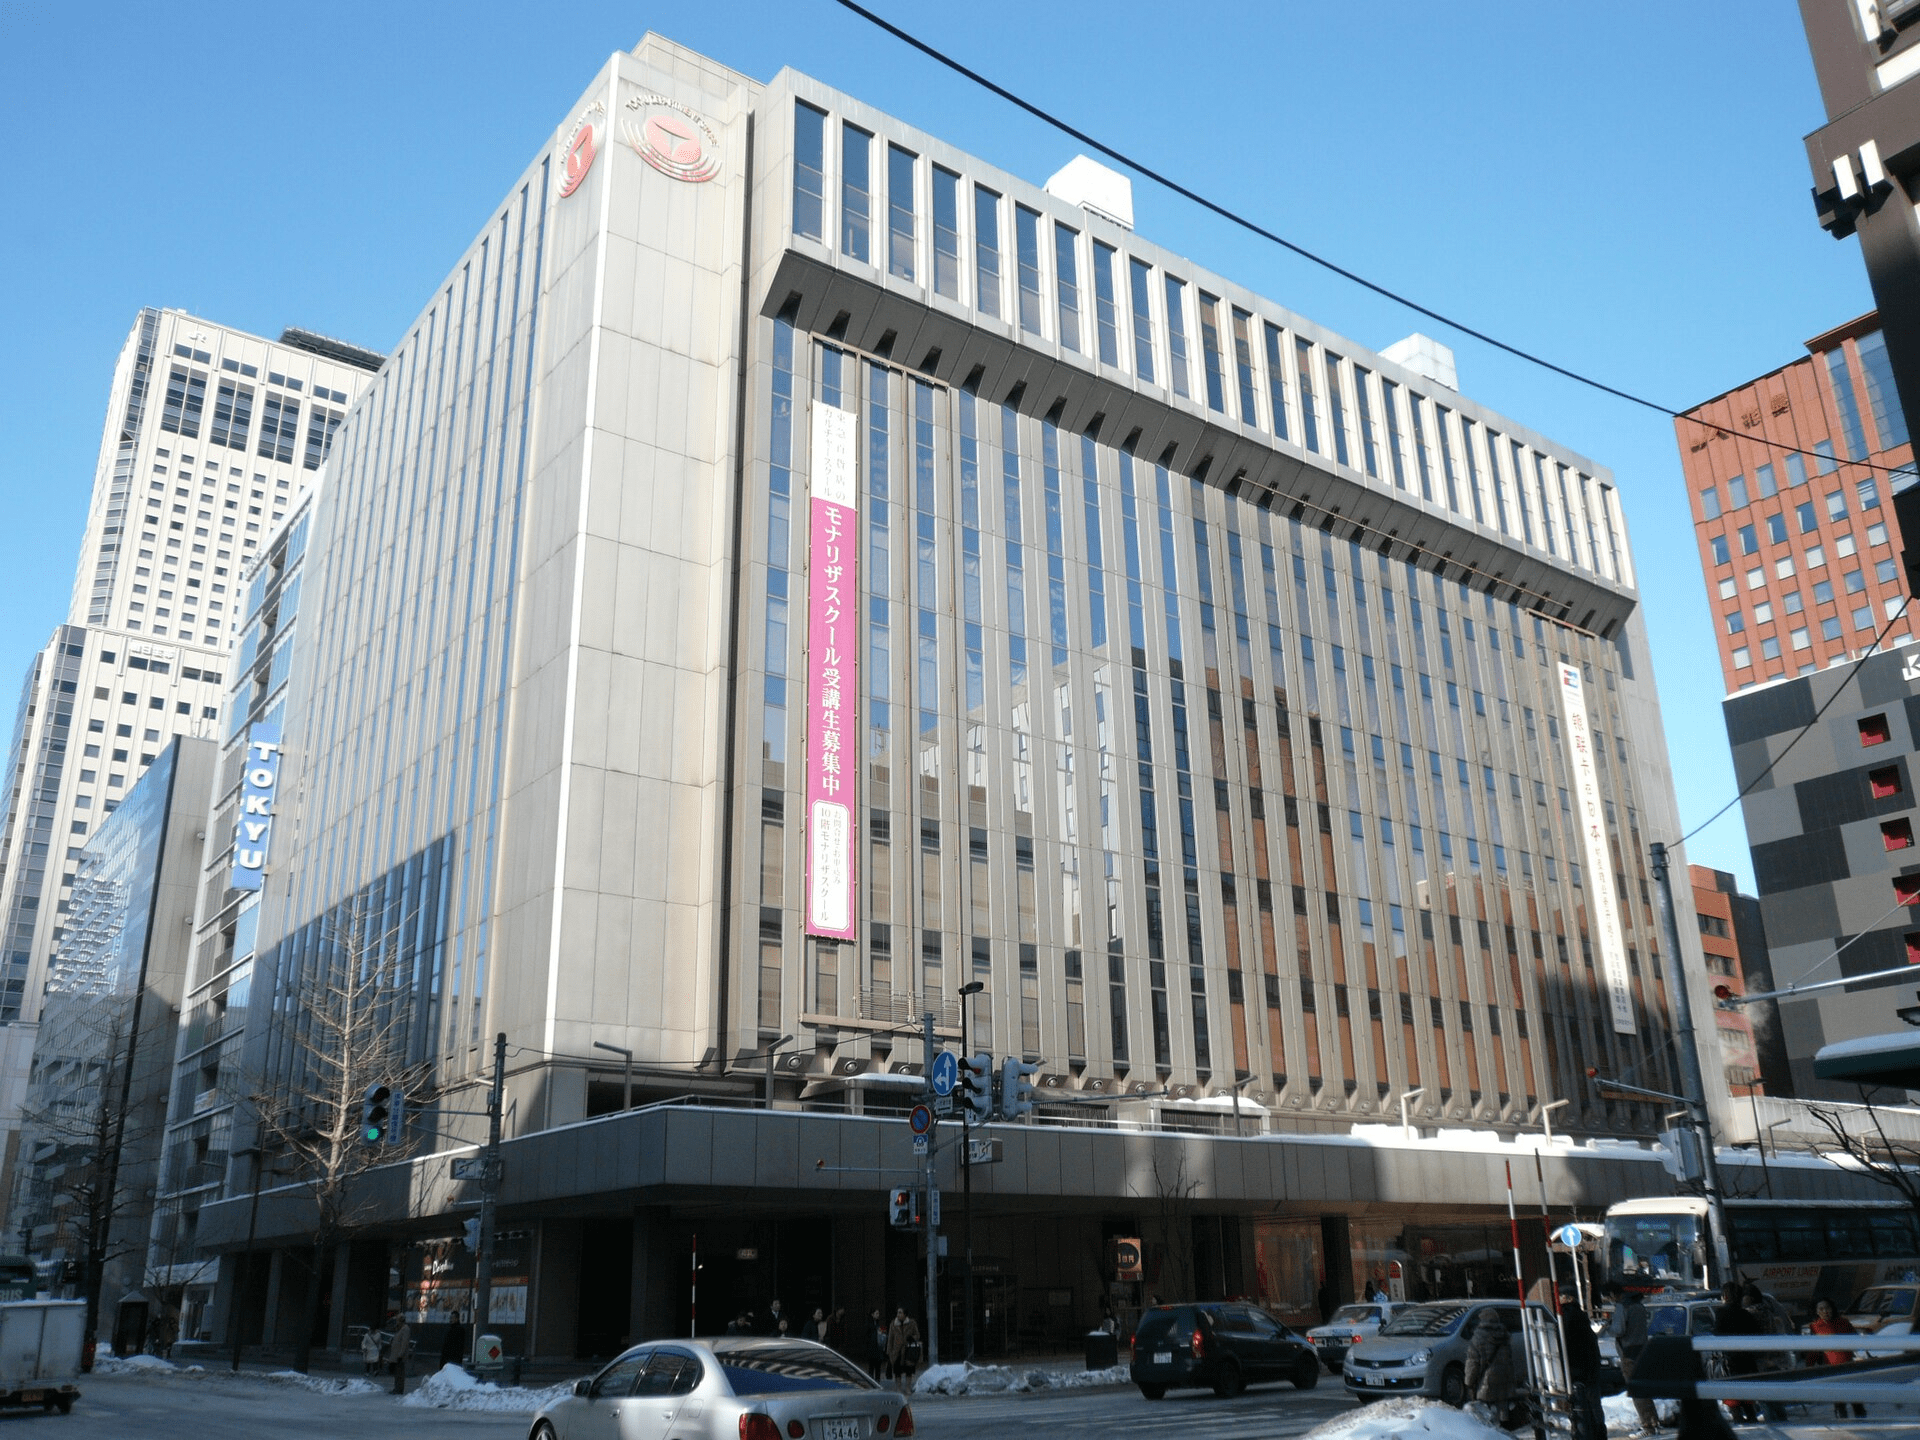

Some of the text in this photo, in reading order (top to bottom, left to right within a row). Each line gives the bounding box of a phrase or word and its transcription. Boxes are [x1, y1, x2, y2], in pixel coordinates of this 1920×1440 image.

[821, 505, 843, 797] モナリザスクール受講生募集中
[239, 741, 278, 869] TOKYU
